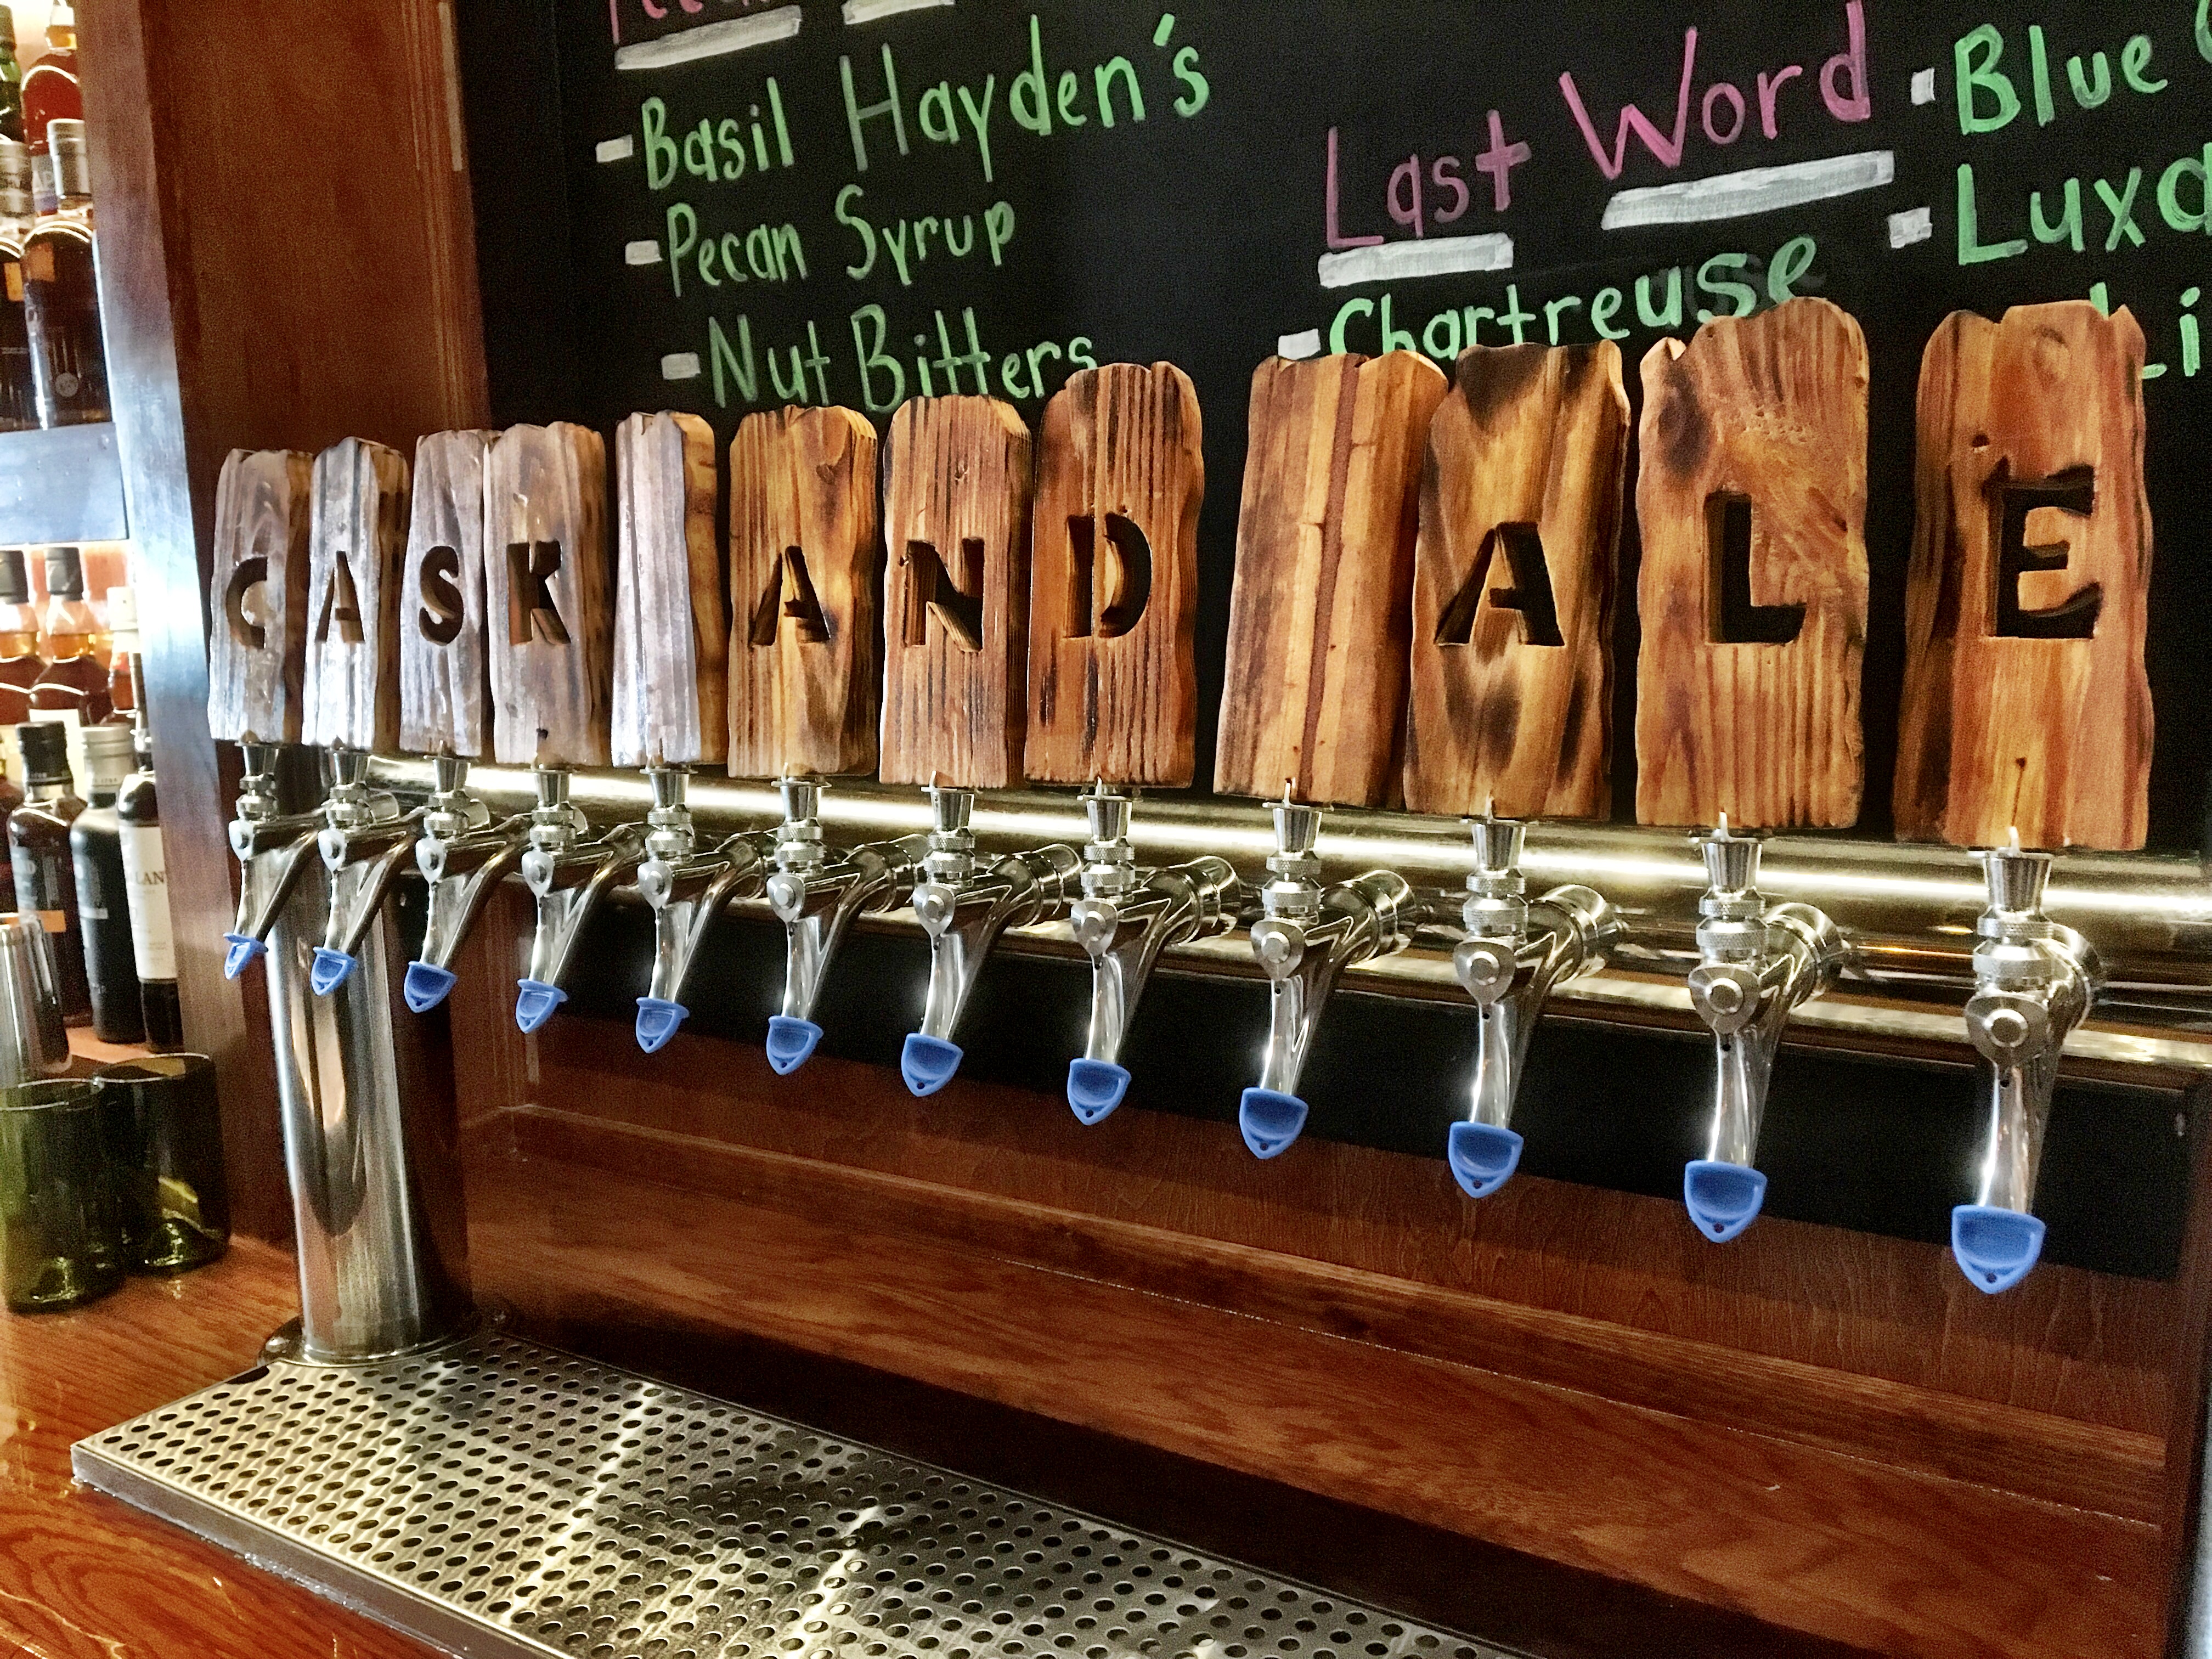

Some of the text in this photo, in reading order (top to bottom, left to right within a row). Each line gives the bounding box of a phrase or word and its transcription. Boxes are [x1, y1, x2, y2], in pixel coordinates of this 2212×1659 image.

[641, 13, 1210, 190] Basil Hayden's
[1327, 0, 1871, 249] Last Word
[1954, 23, 2168, 136] Blue
[667, 184, 1015, 297] Pecan Syrup
[1329, 235, 1816, 360] Chartreuse
[708, 303, 1098, 413] Nut Bitters
[225, 463, 2102, 653] CASK AND ALE
